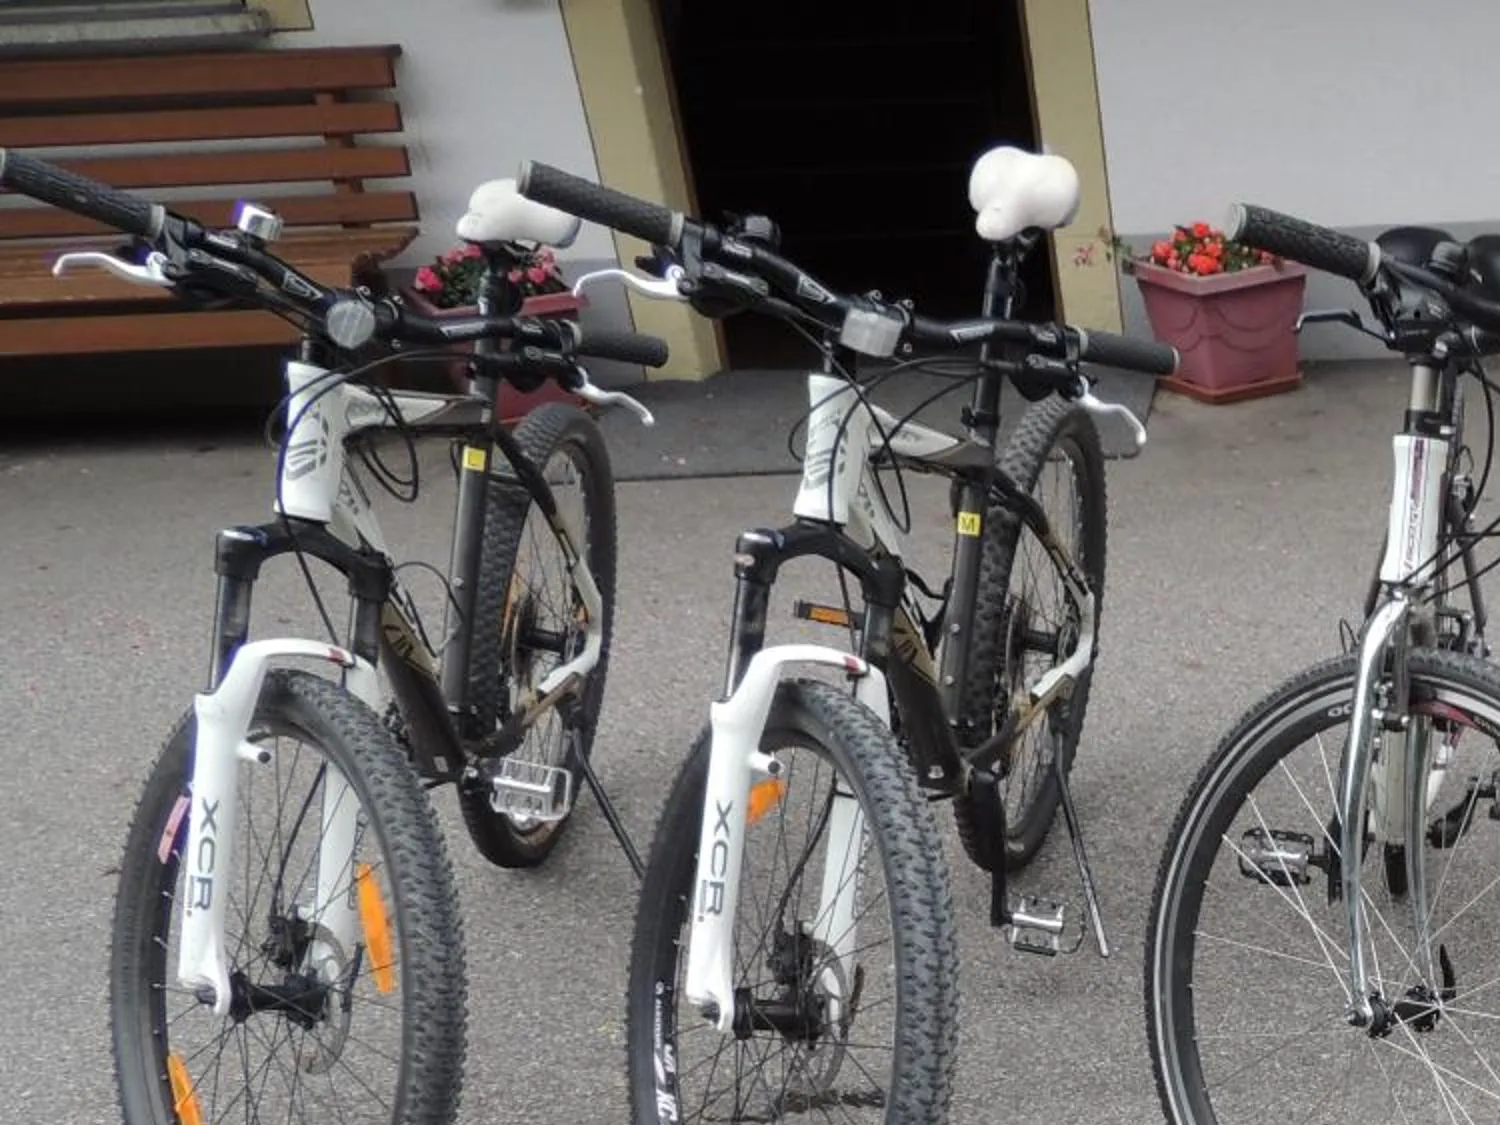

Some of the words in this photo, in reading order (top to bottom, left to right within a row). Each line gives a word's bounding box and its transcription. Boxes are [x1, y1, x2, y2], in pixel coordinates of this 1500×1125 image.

[960, 515, 976, 533] M
[193, 797, 220, 911] XCR
[706, 799, 734, 916] XCR
